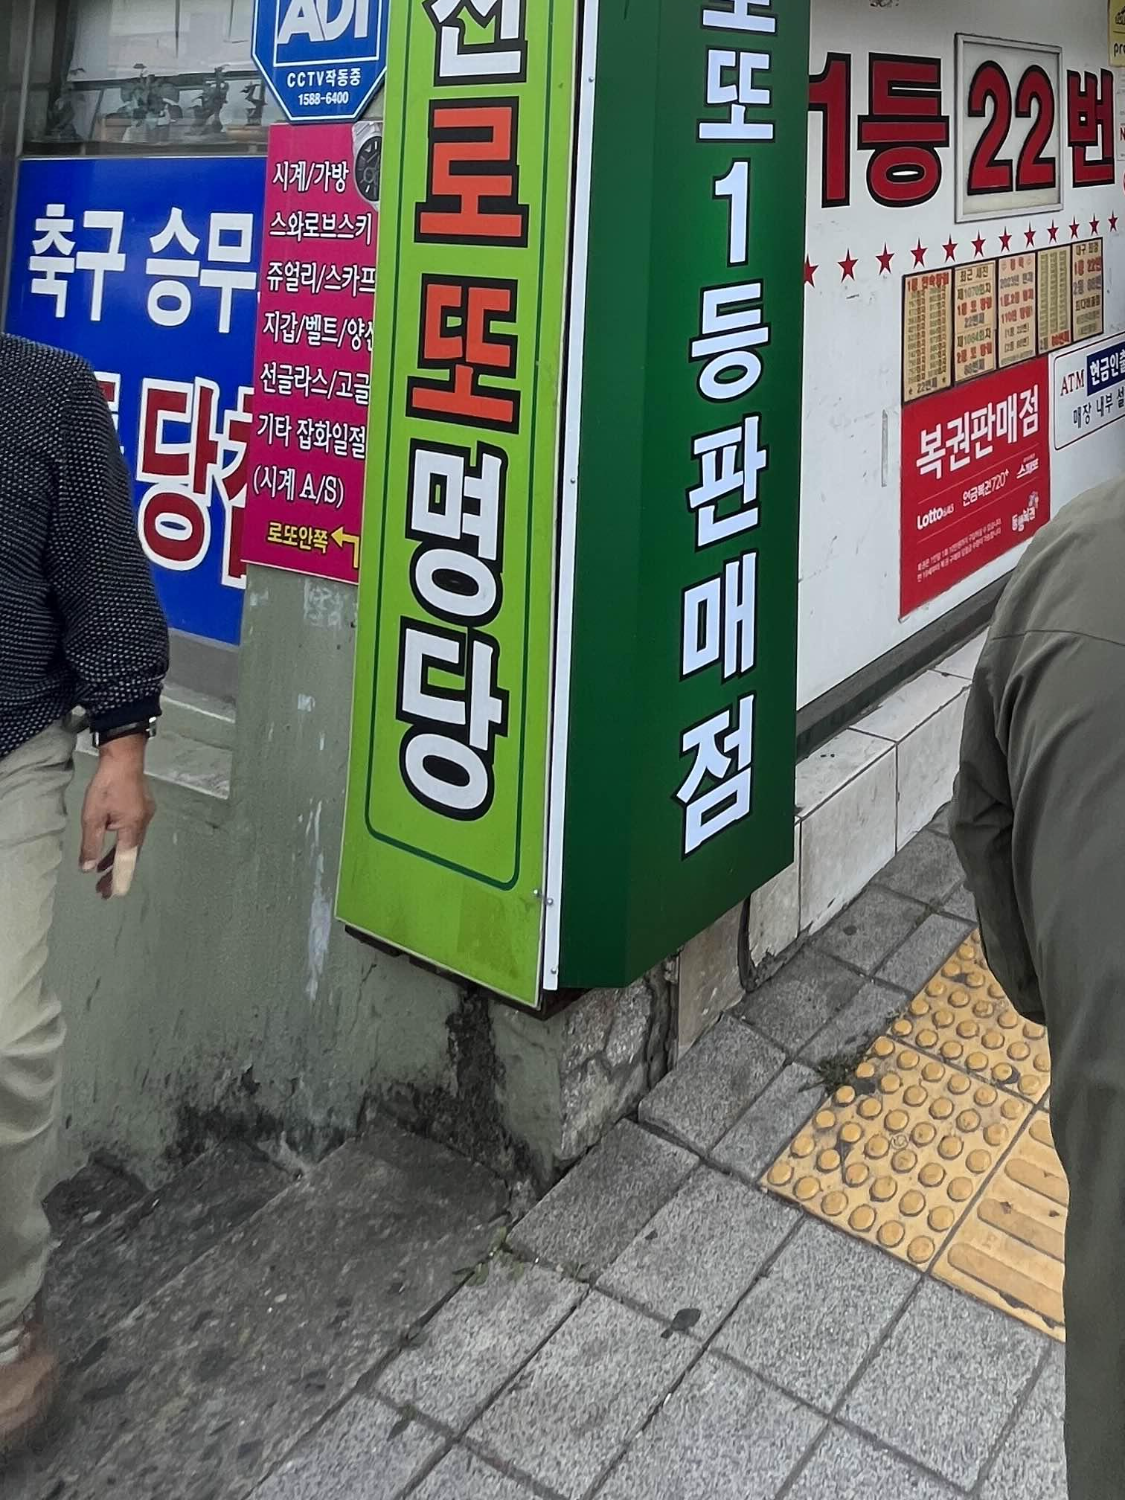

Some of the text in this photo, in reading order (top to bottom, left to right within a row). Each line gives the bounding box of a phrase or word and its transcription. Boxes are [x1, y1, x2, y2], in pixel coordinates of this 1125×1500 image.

[287, 67, 361, 88] CCTV작동중
[298, 92, 349, 106] 1588-6400
[272, 160, 349, 192] 시계/가방
[269, 210, 373, 245] 스와로브스키
[29, 203, 127, 322] 축구
[266, 262, 376, 297] 쥬얼리/스카프
[260, 362, 370, 405] 선글라스/고글
[1060, 369, 1085, 396] ATM
[1073, 402, 1092, 429] 매장
[1096, 392, 1114, 417] 내부
[257, 413, 366, 459] 기타 잡화일절
[916, 384, 1039, 480] 복권판매점
[253, 465, 344, 509] (시계 A/S)
[267, 521, 328, 554] 로또안쪽
